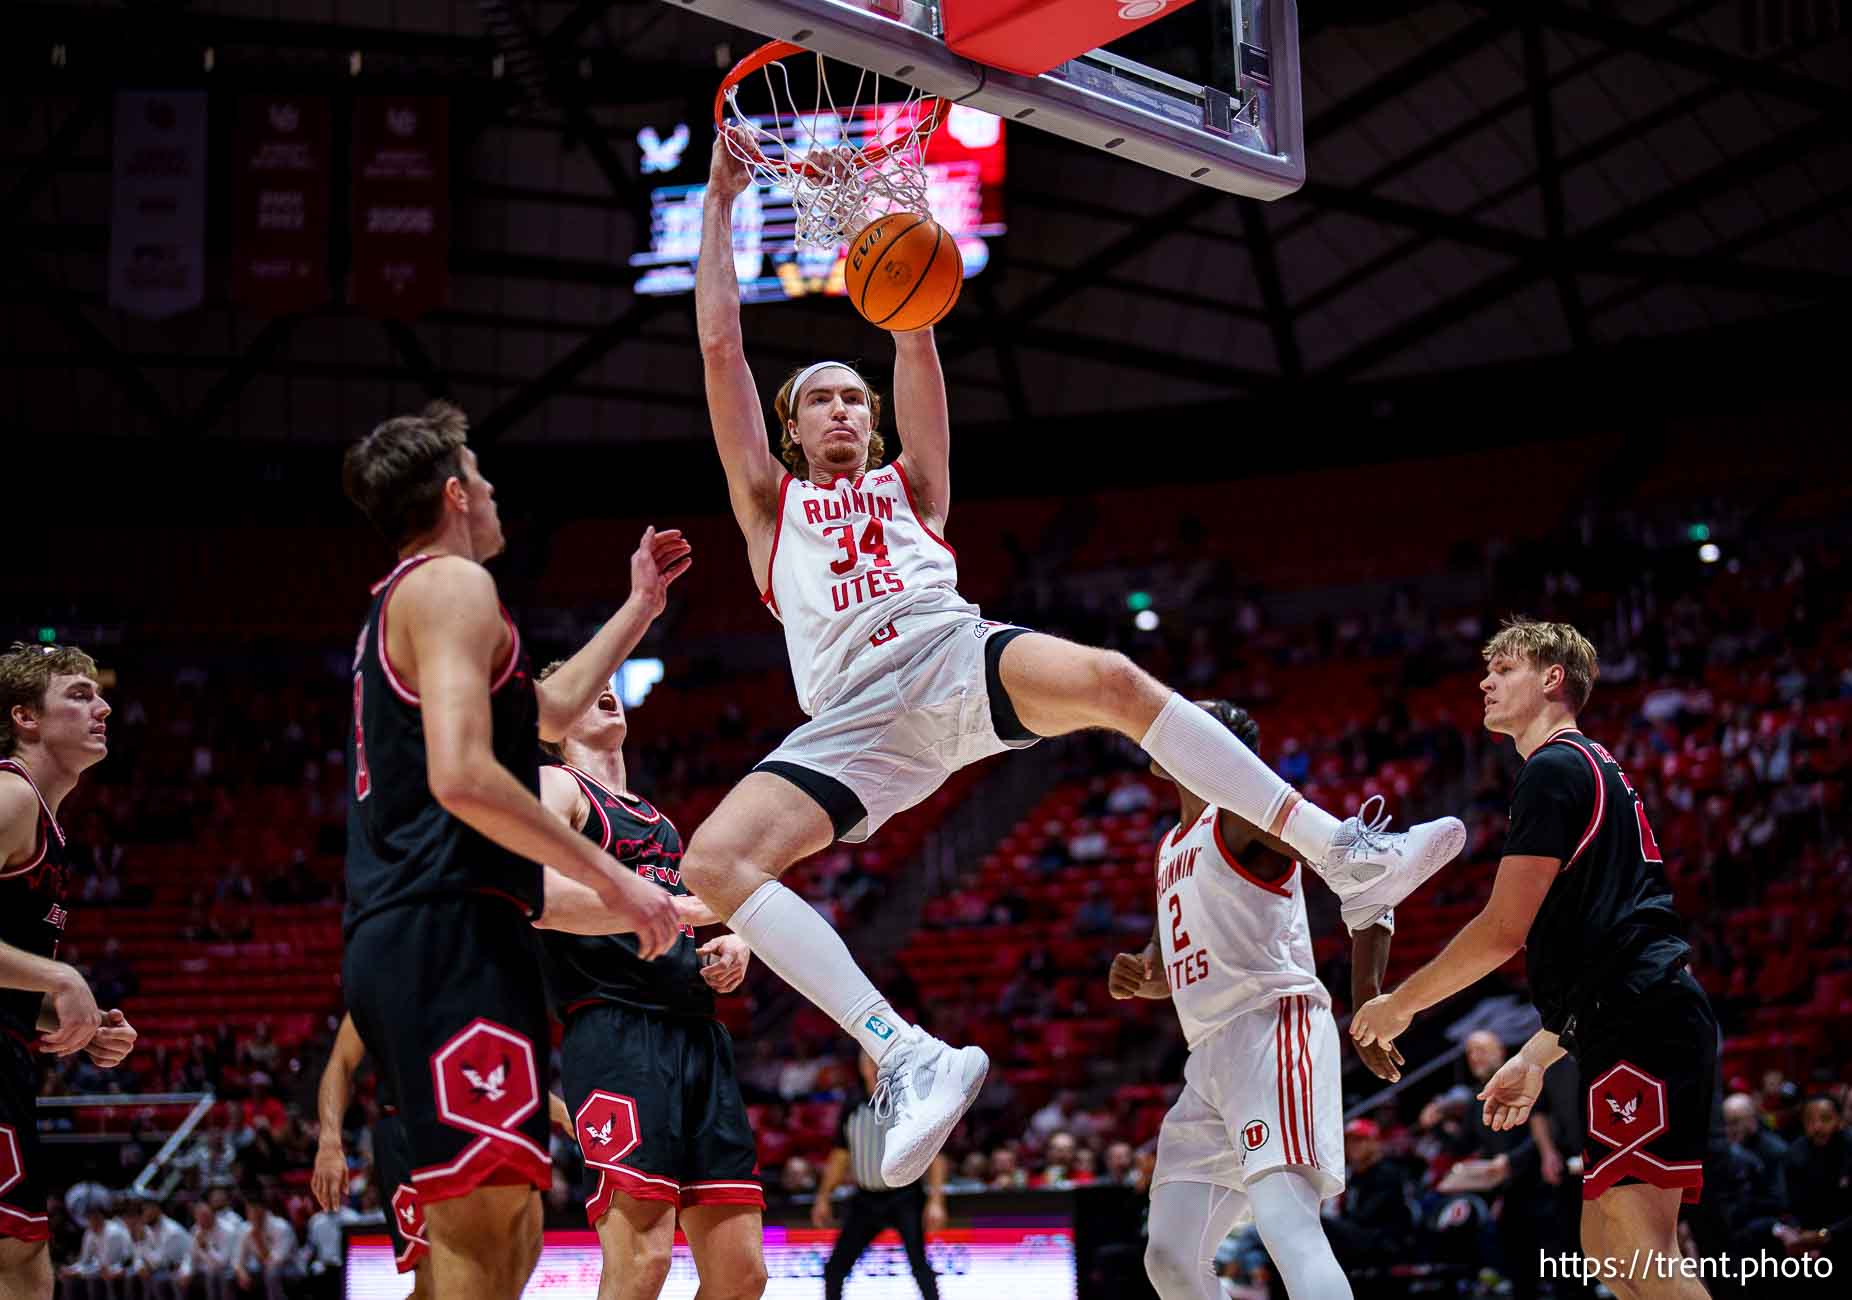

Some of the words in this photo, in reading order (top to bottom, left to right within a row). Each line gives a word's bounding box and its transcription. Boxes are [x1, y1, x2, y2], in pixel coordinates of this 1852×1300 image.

[822, 516, 892, 575] 34
[831, 569, 905, 612] UTES
[1169, 893, 1192, 952] 2
